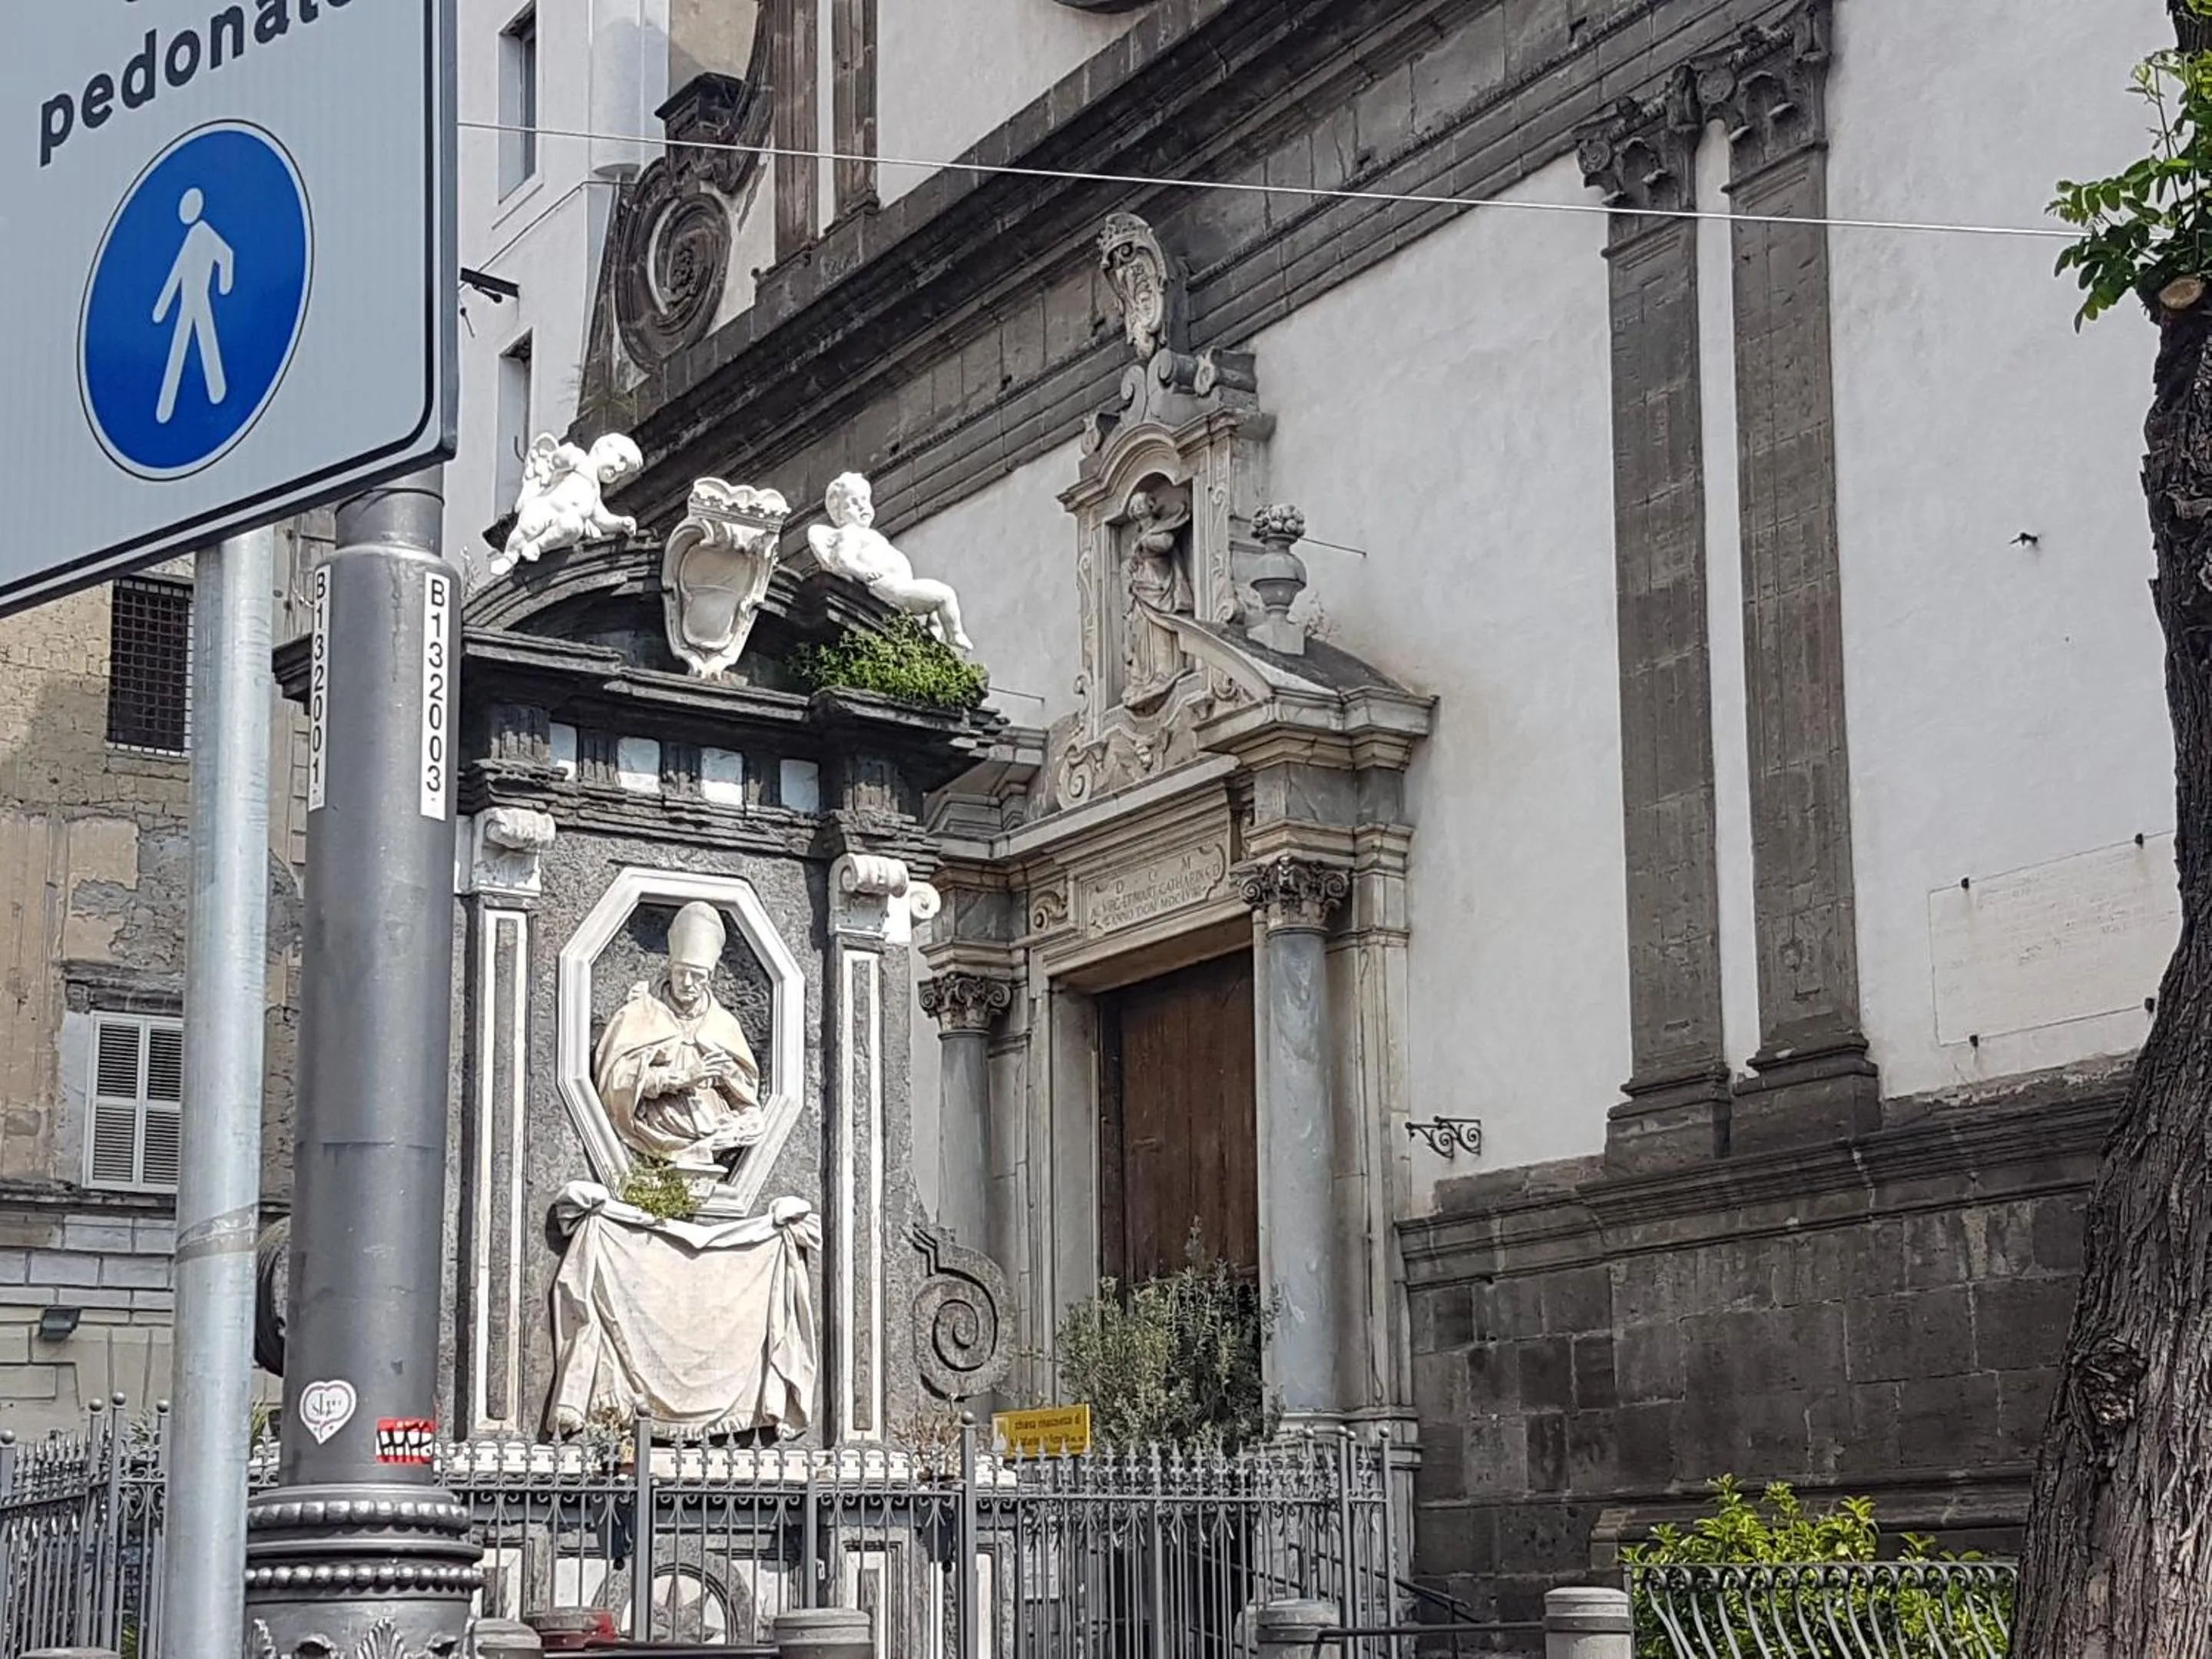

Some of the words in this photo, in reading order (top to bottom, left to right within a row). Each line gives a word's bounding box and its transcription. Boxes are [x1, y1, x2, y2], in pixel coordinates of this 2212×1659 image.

[39, 0, 351, 167] pedona
[312, 572, 326, 784] B132001
[426, 579, 445, 792] B132003
